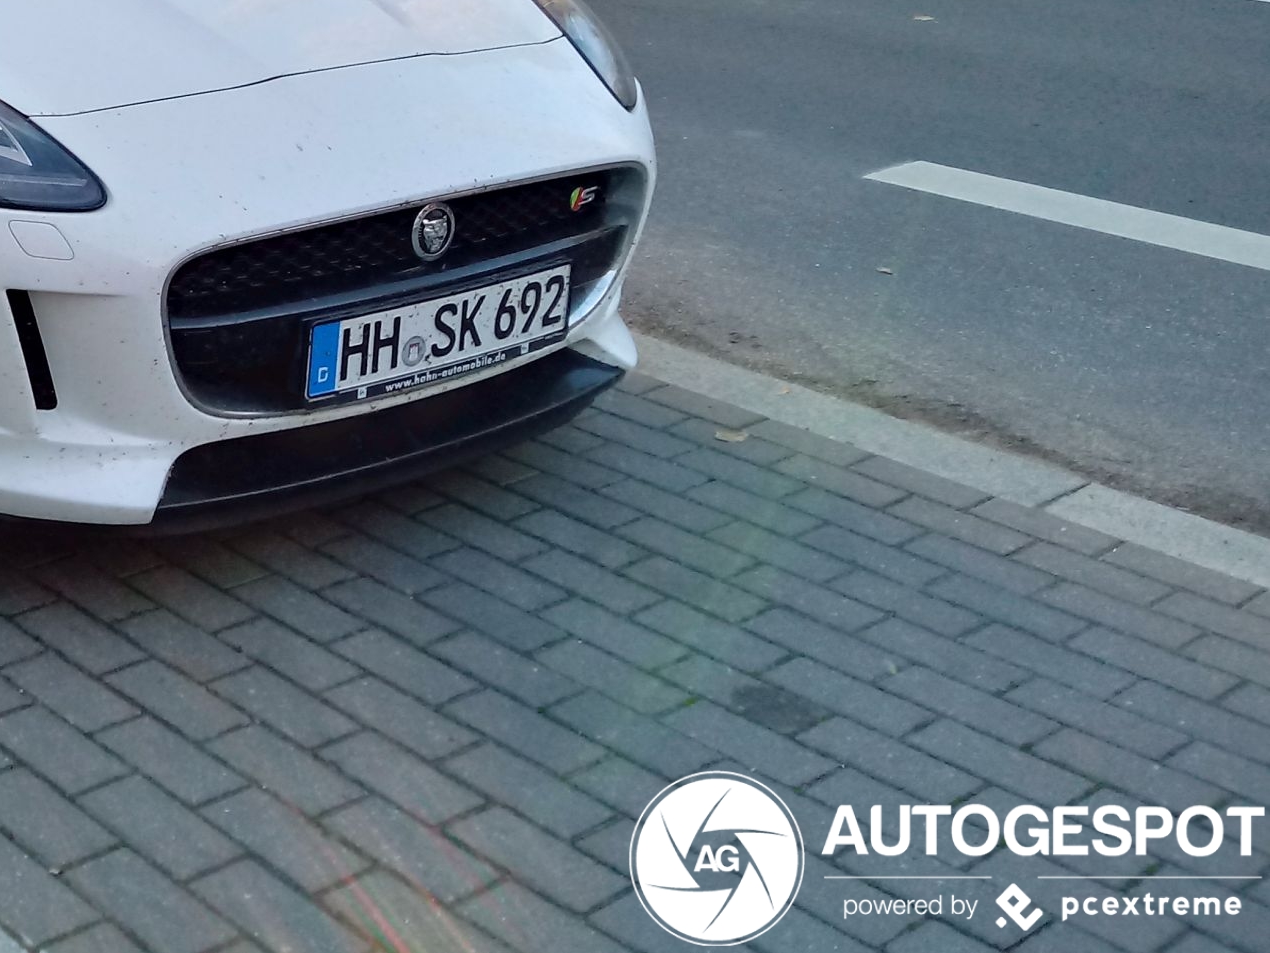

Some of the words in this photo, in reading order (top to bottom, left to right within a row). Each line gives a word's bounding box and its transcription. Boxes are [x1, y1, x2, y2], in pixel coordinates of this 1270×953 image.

[578, 185, 600, 206] S
[339, 315, 402, 382] HH
[431, 294, 486, 358] SK
[493, 274, 565, 340] 692
[317, 366, 329, 384] D
[385, 351, 506, 393] www.hahn-automobile.de
